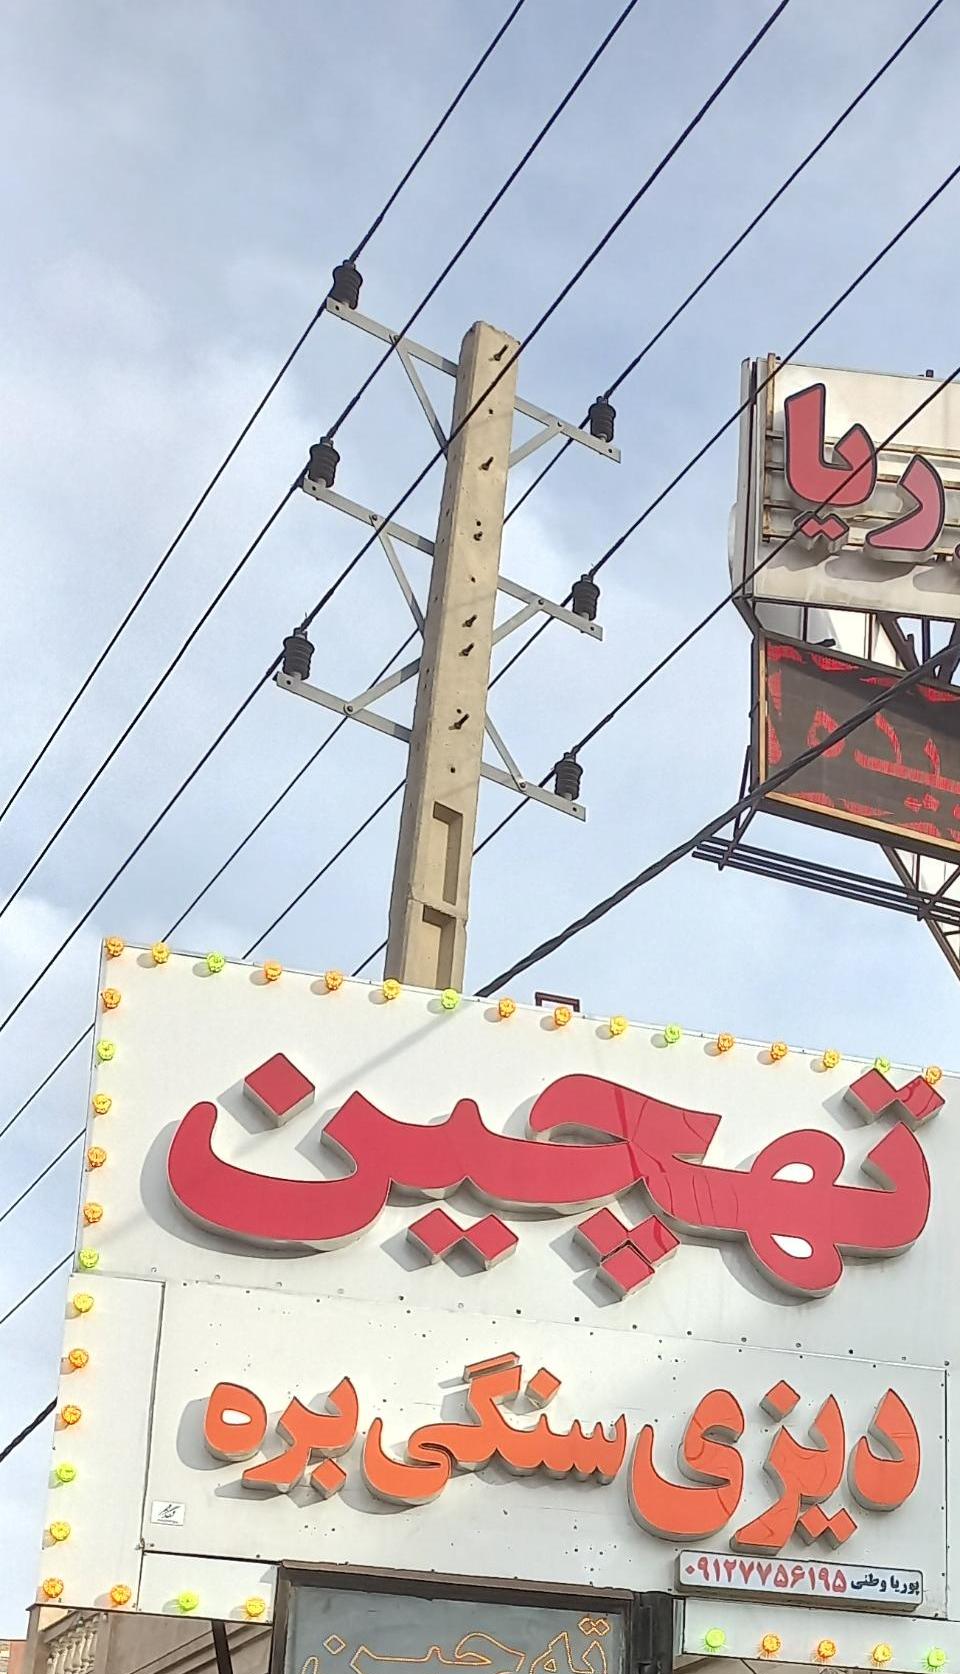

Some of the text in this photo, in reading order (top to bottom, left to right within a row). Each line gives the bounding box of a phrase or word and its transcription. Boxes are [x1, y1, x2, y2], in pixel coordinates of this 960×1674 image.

[203, 1353, 922, 1554] دیزی سنگی بره
[685, 1556, 920, 1595] پوریا وطنی ۰۹۱۲۷۷۵۶۱۹۵
